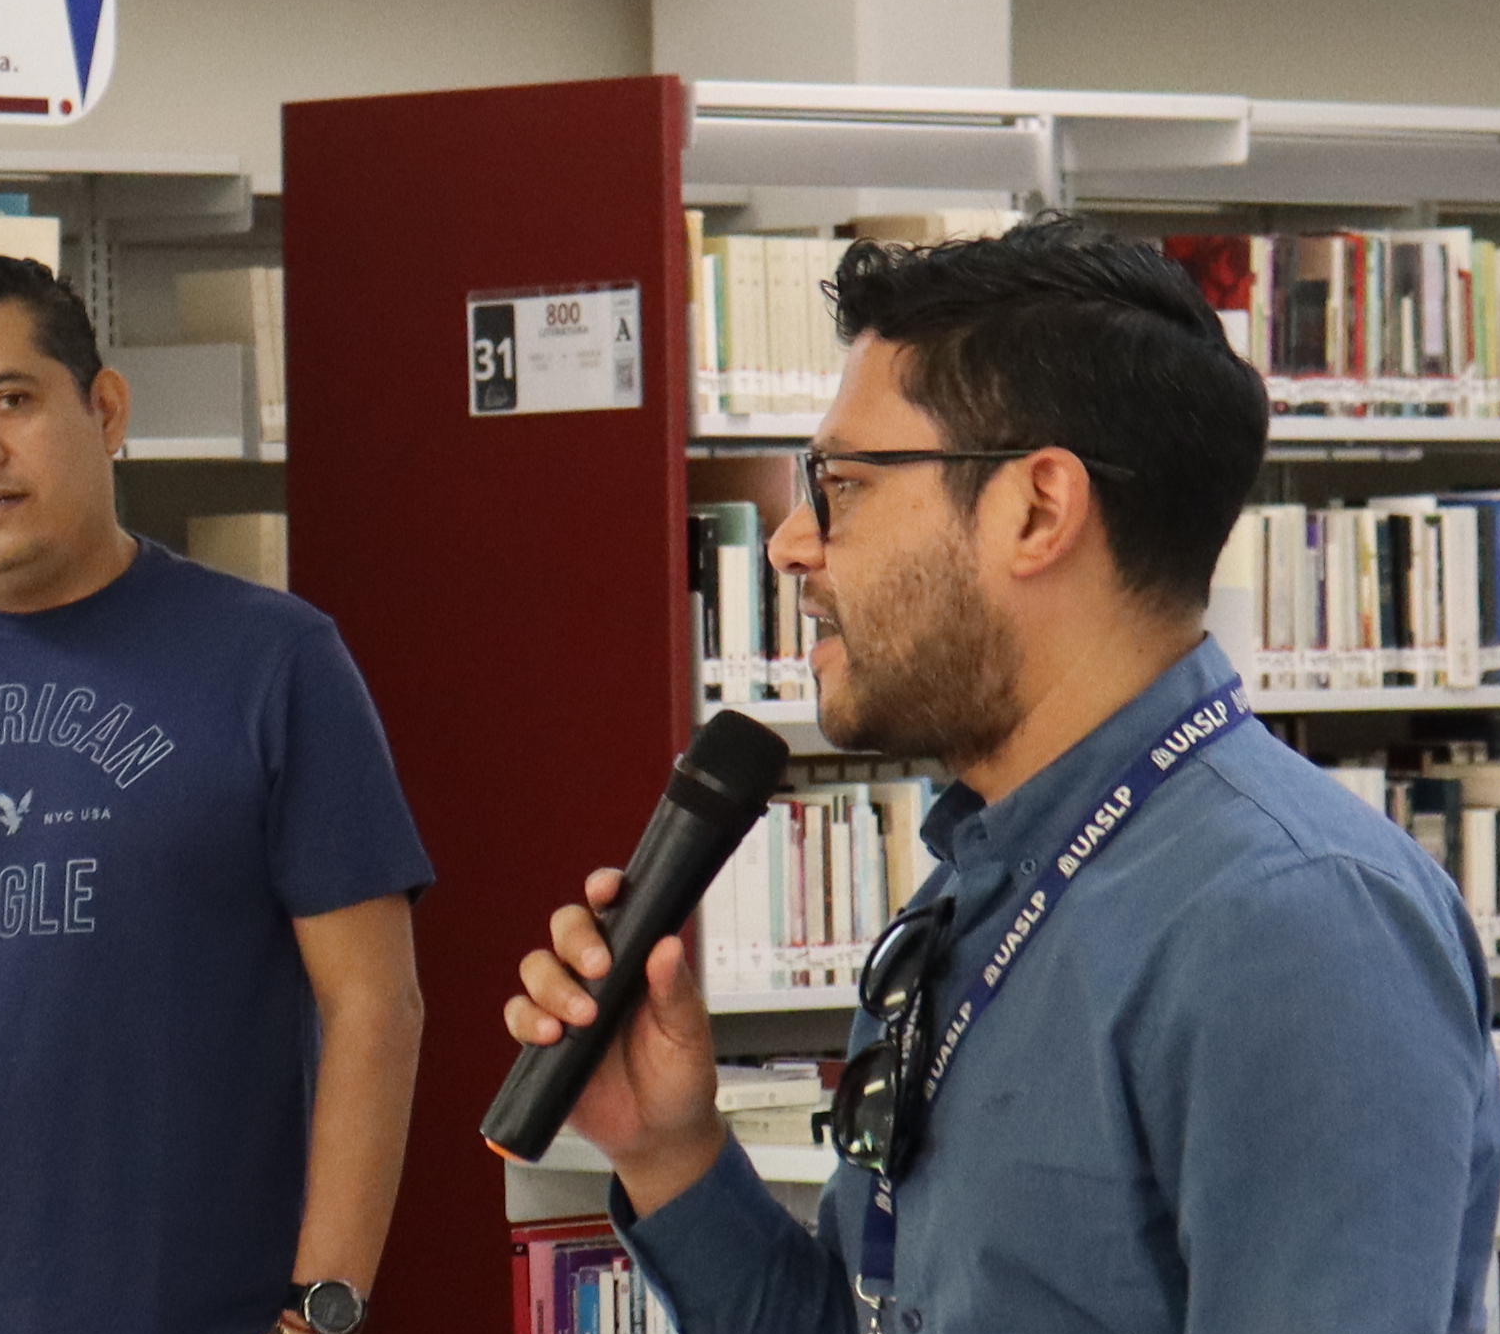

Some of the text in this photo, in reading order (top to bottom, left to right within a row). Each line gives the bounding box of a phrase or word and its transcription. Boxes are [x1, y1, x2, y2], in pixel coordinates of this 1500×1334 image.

[546, 302, 582, 326] 800
[615, 318, 632, 342] A
[473, 336, 514, 382] 31
[1163, 699, 1230, 760] UASLP
[43, 806, 112, 826] NYC USA
[1068, 785, 1133, 861] UASLP
[993, 889, 1048, 967] UASLP
[931, 1000, 974, 1080] UASLP
